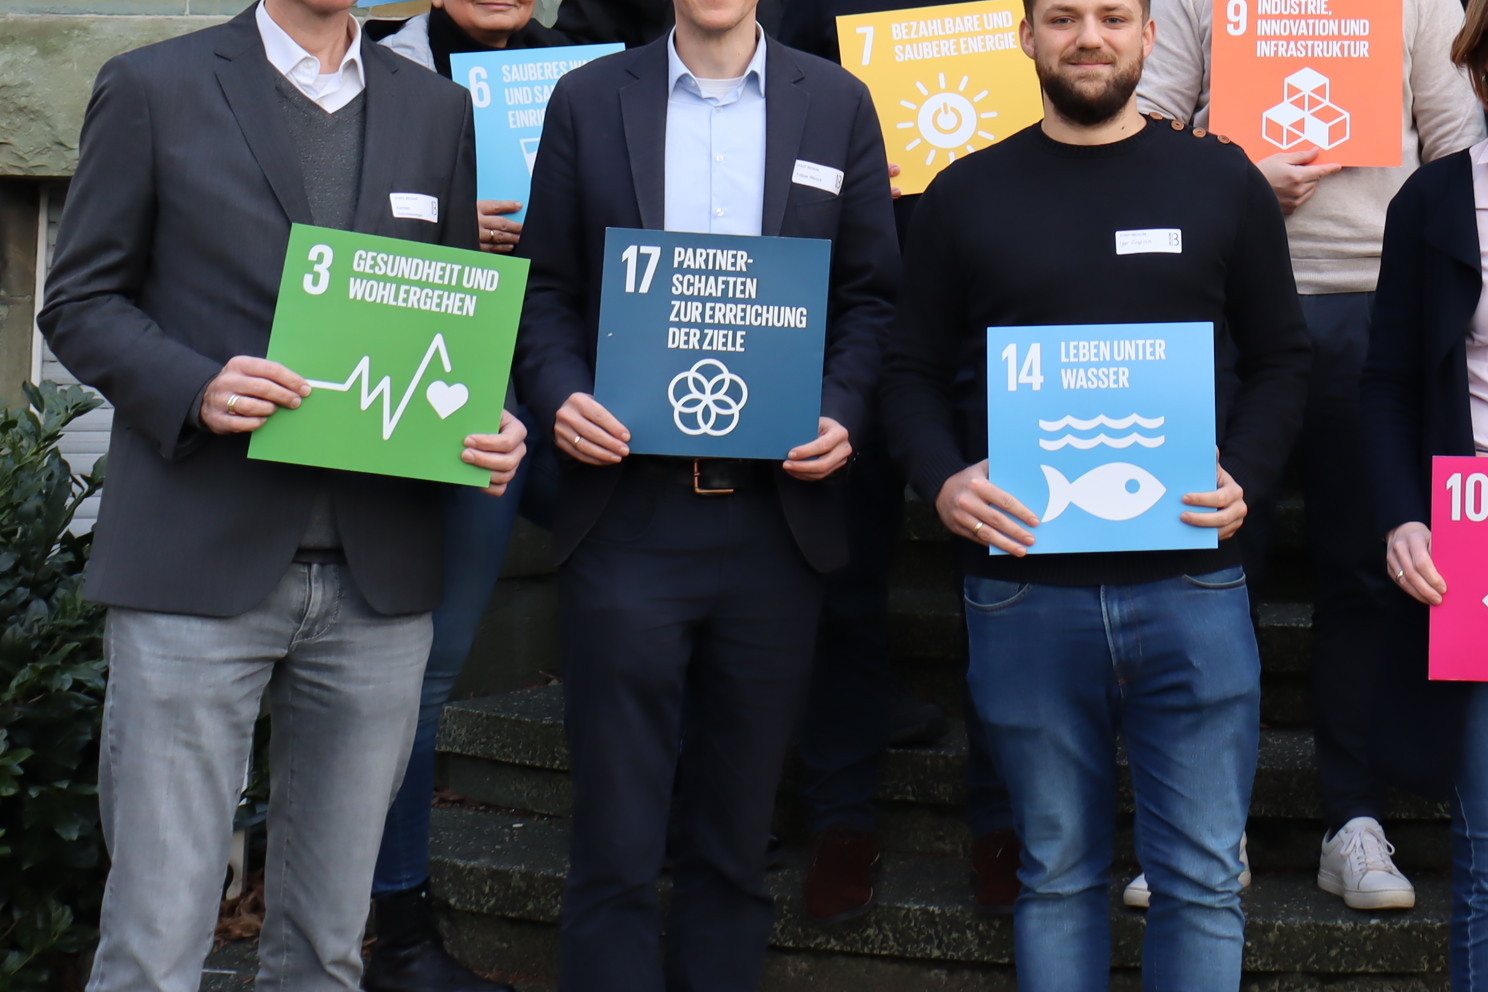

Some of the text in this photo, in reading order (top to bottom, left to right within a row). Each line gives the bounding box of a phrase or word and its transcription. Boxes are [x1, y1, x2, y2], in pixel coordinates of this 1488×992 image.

[891, 10, 1013, 41] BEZAHLBARE UND
[1257, 19, 1370, 36] INNOVATION UND
[855, 26, 874, 66] 7
[894, 32, 1018, 62] SAUBERE ENERGIE
[1256, 40, 1369, 57] INFRASTRUKTUR
[468, 66, 491, 108] 6
[505, 86, 533, 106] UND
[302, 244, 334, 295] 3
[353, 249, 499, 292] GESUNDHEIT UND
[621, 244, 661, 294] 17
[673, 247, 753, 272] PARTNER-
[349, 277, 477, 317] WOHLERGEHEN
[671, 274, 757, 299] SCHAFTEN
[669, 300, 807, 328] ZUR ERREICHUNG
[667, 327, 746, 352] DER ZIELE
[1060, 339, 1166, 363] LEBEN UNTER
[1001, 342, 1044, 392] 14
[1061, 367, 1130, 390] WASSER
